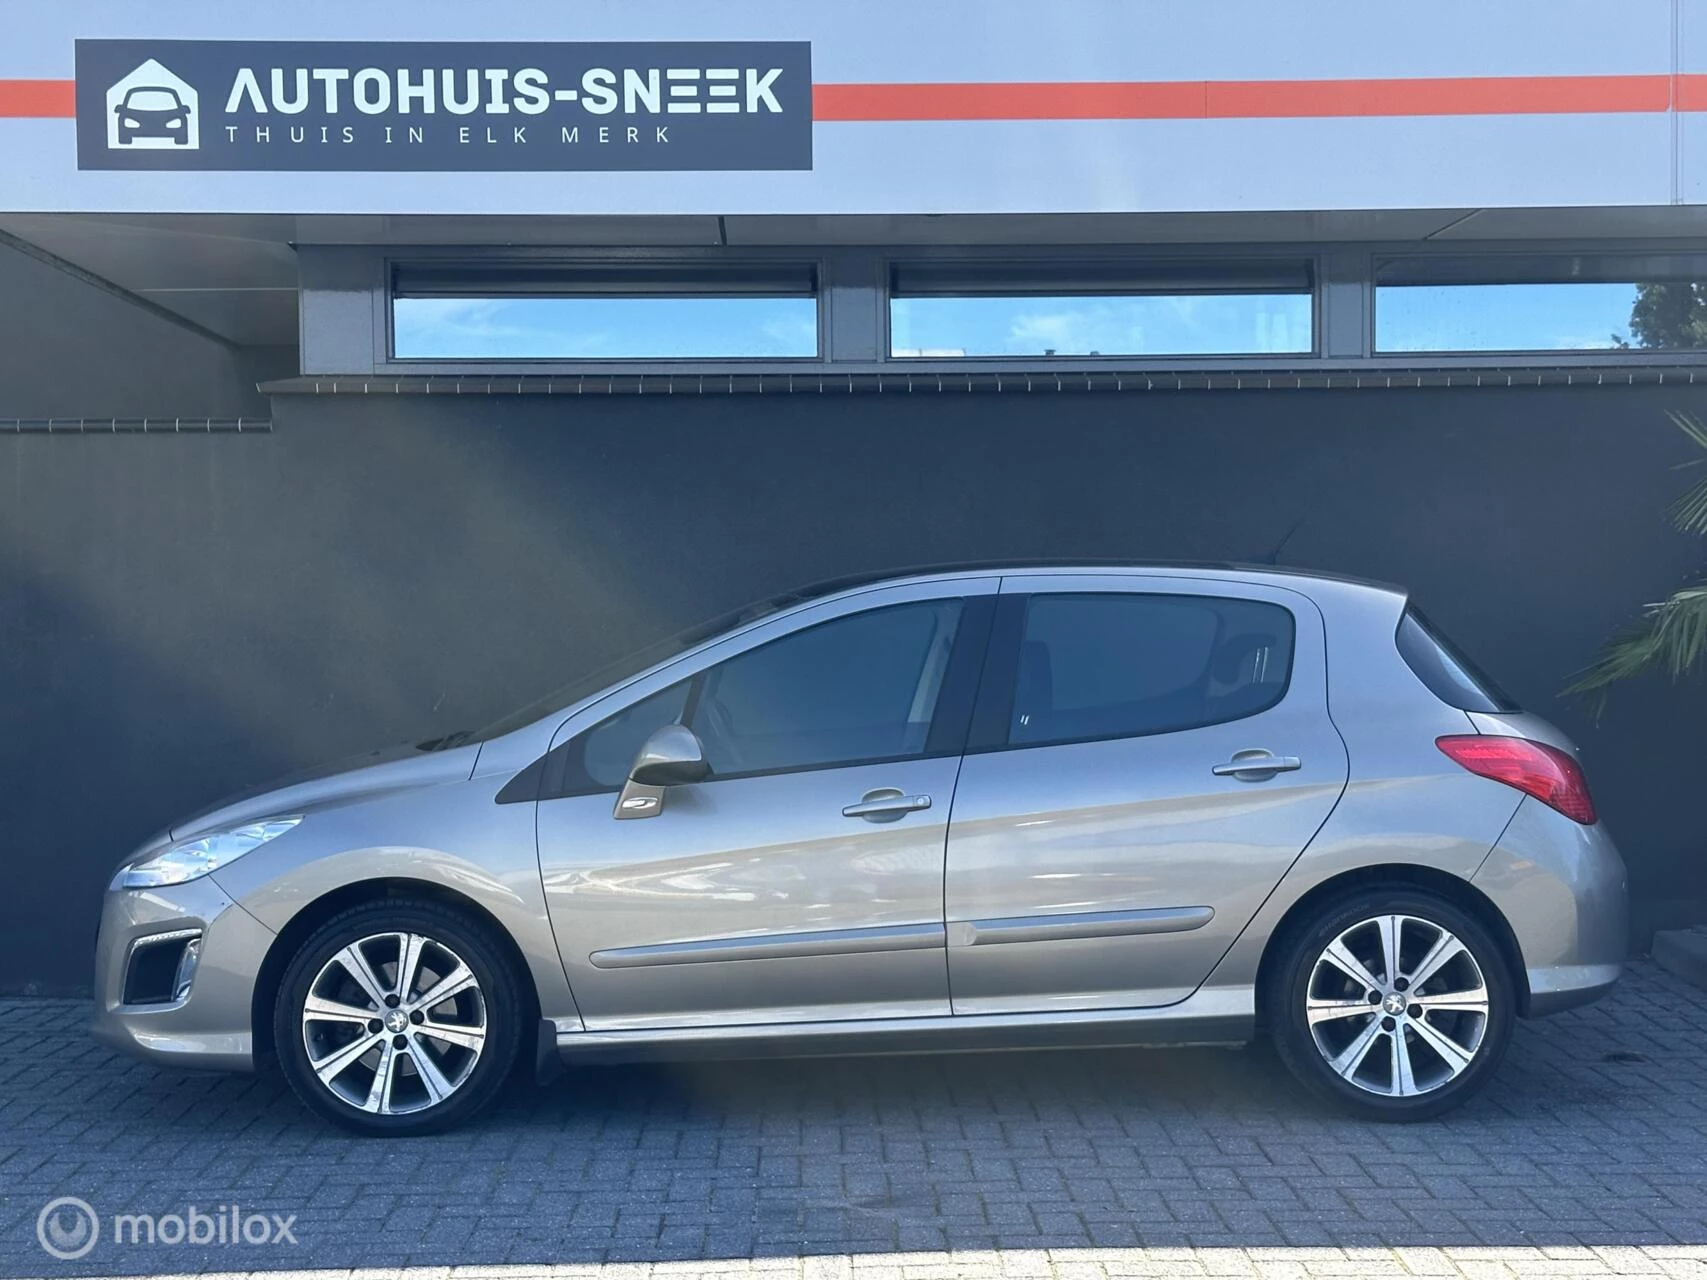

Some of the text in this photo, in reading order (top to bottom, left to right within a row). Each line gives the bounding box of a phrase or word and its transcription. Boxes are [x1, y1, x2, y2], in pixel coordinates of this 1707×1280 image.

[224, 67, 784, 115] AUTOHUIS-SNEEK
[225, 126, 670, 144] THUIS IN ELK MERK
